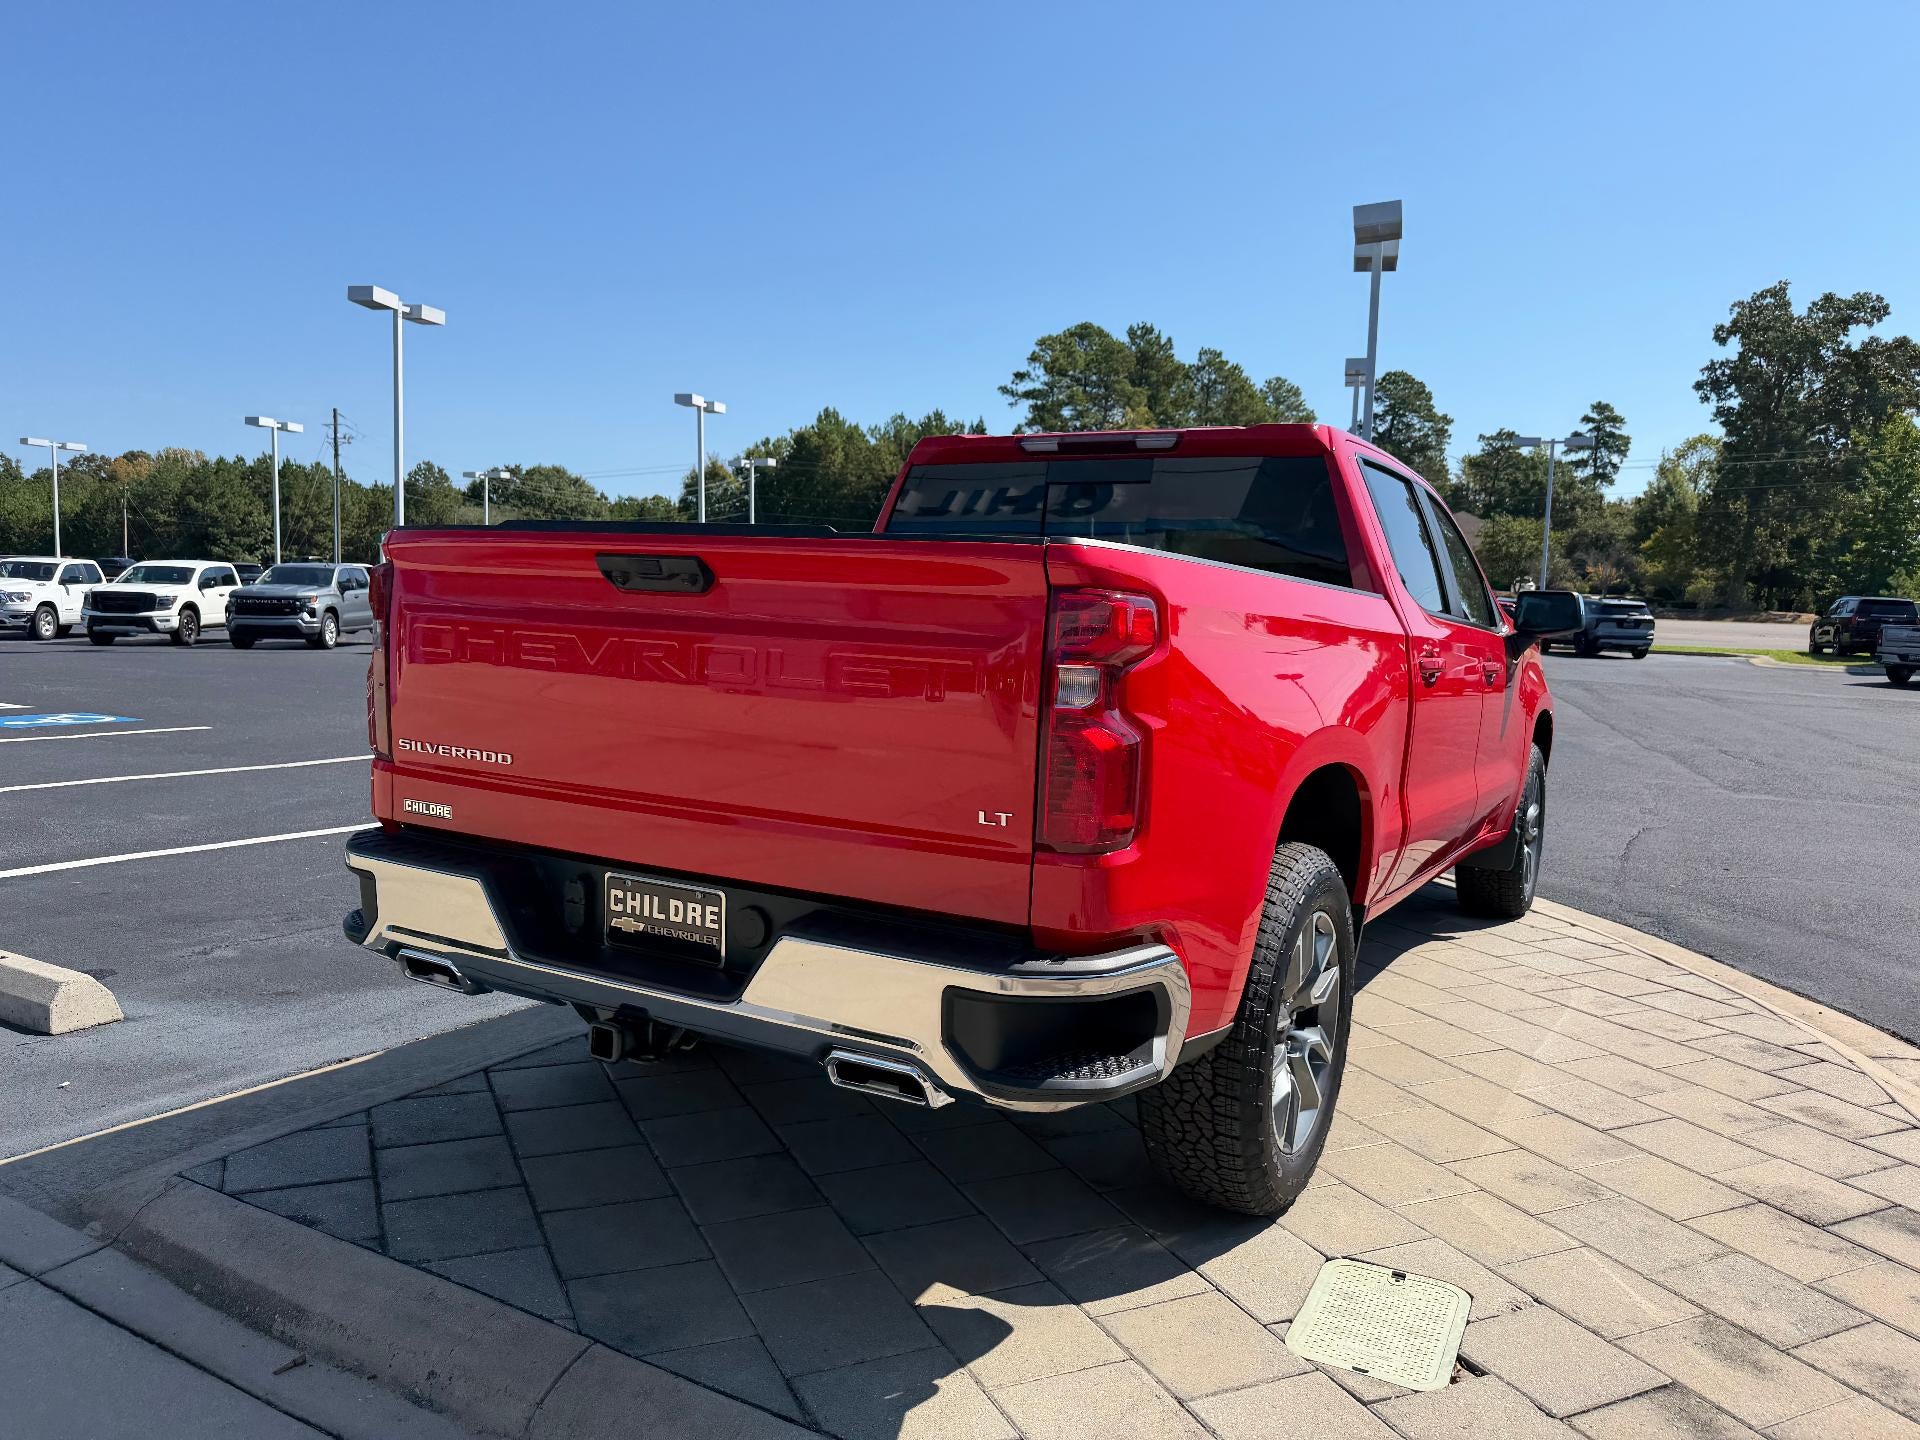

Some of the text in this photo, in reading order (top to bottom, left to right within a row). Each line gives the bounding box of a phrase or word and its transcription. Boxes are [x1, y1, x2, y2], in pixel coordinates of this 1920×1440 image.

[412, 624, 973, 702] CHEVROLET
[398, 738, 513, 766] SILVERADO
[405, 800, 452, 819] CHILDRE
[978, 810, 1013, 827] LT
[609, 888, 720, 930] CHILDRE
[647, 924, 720, 951] CHEVROLET
